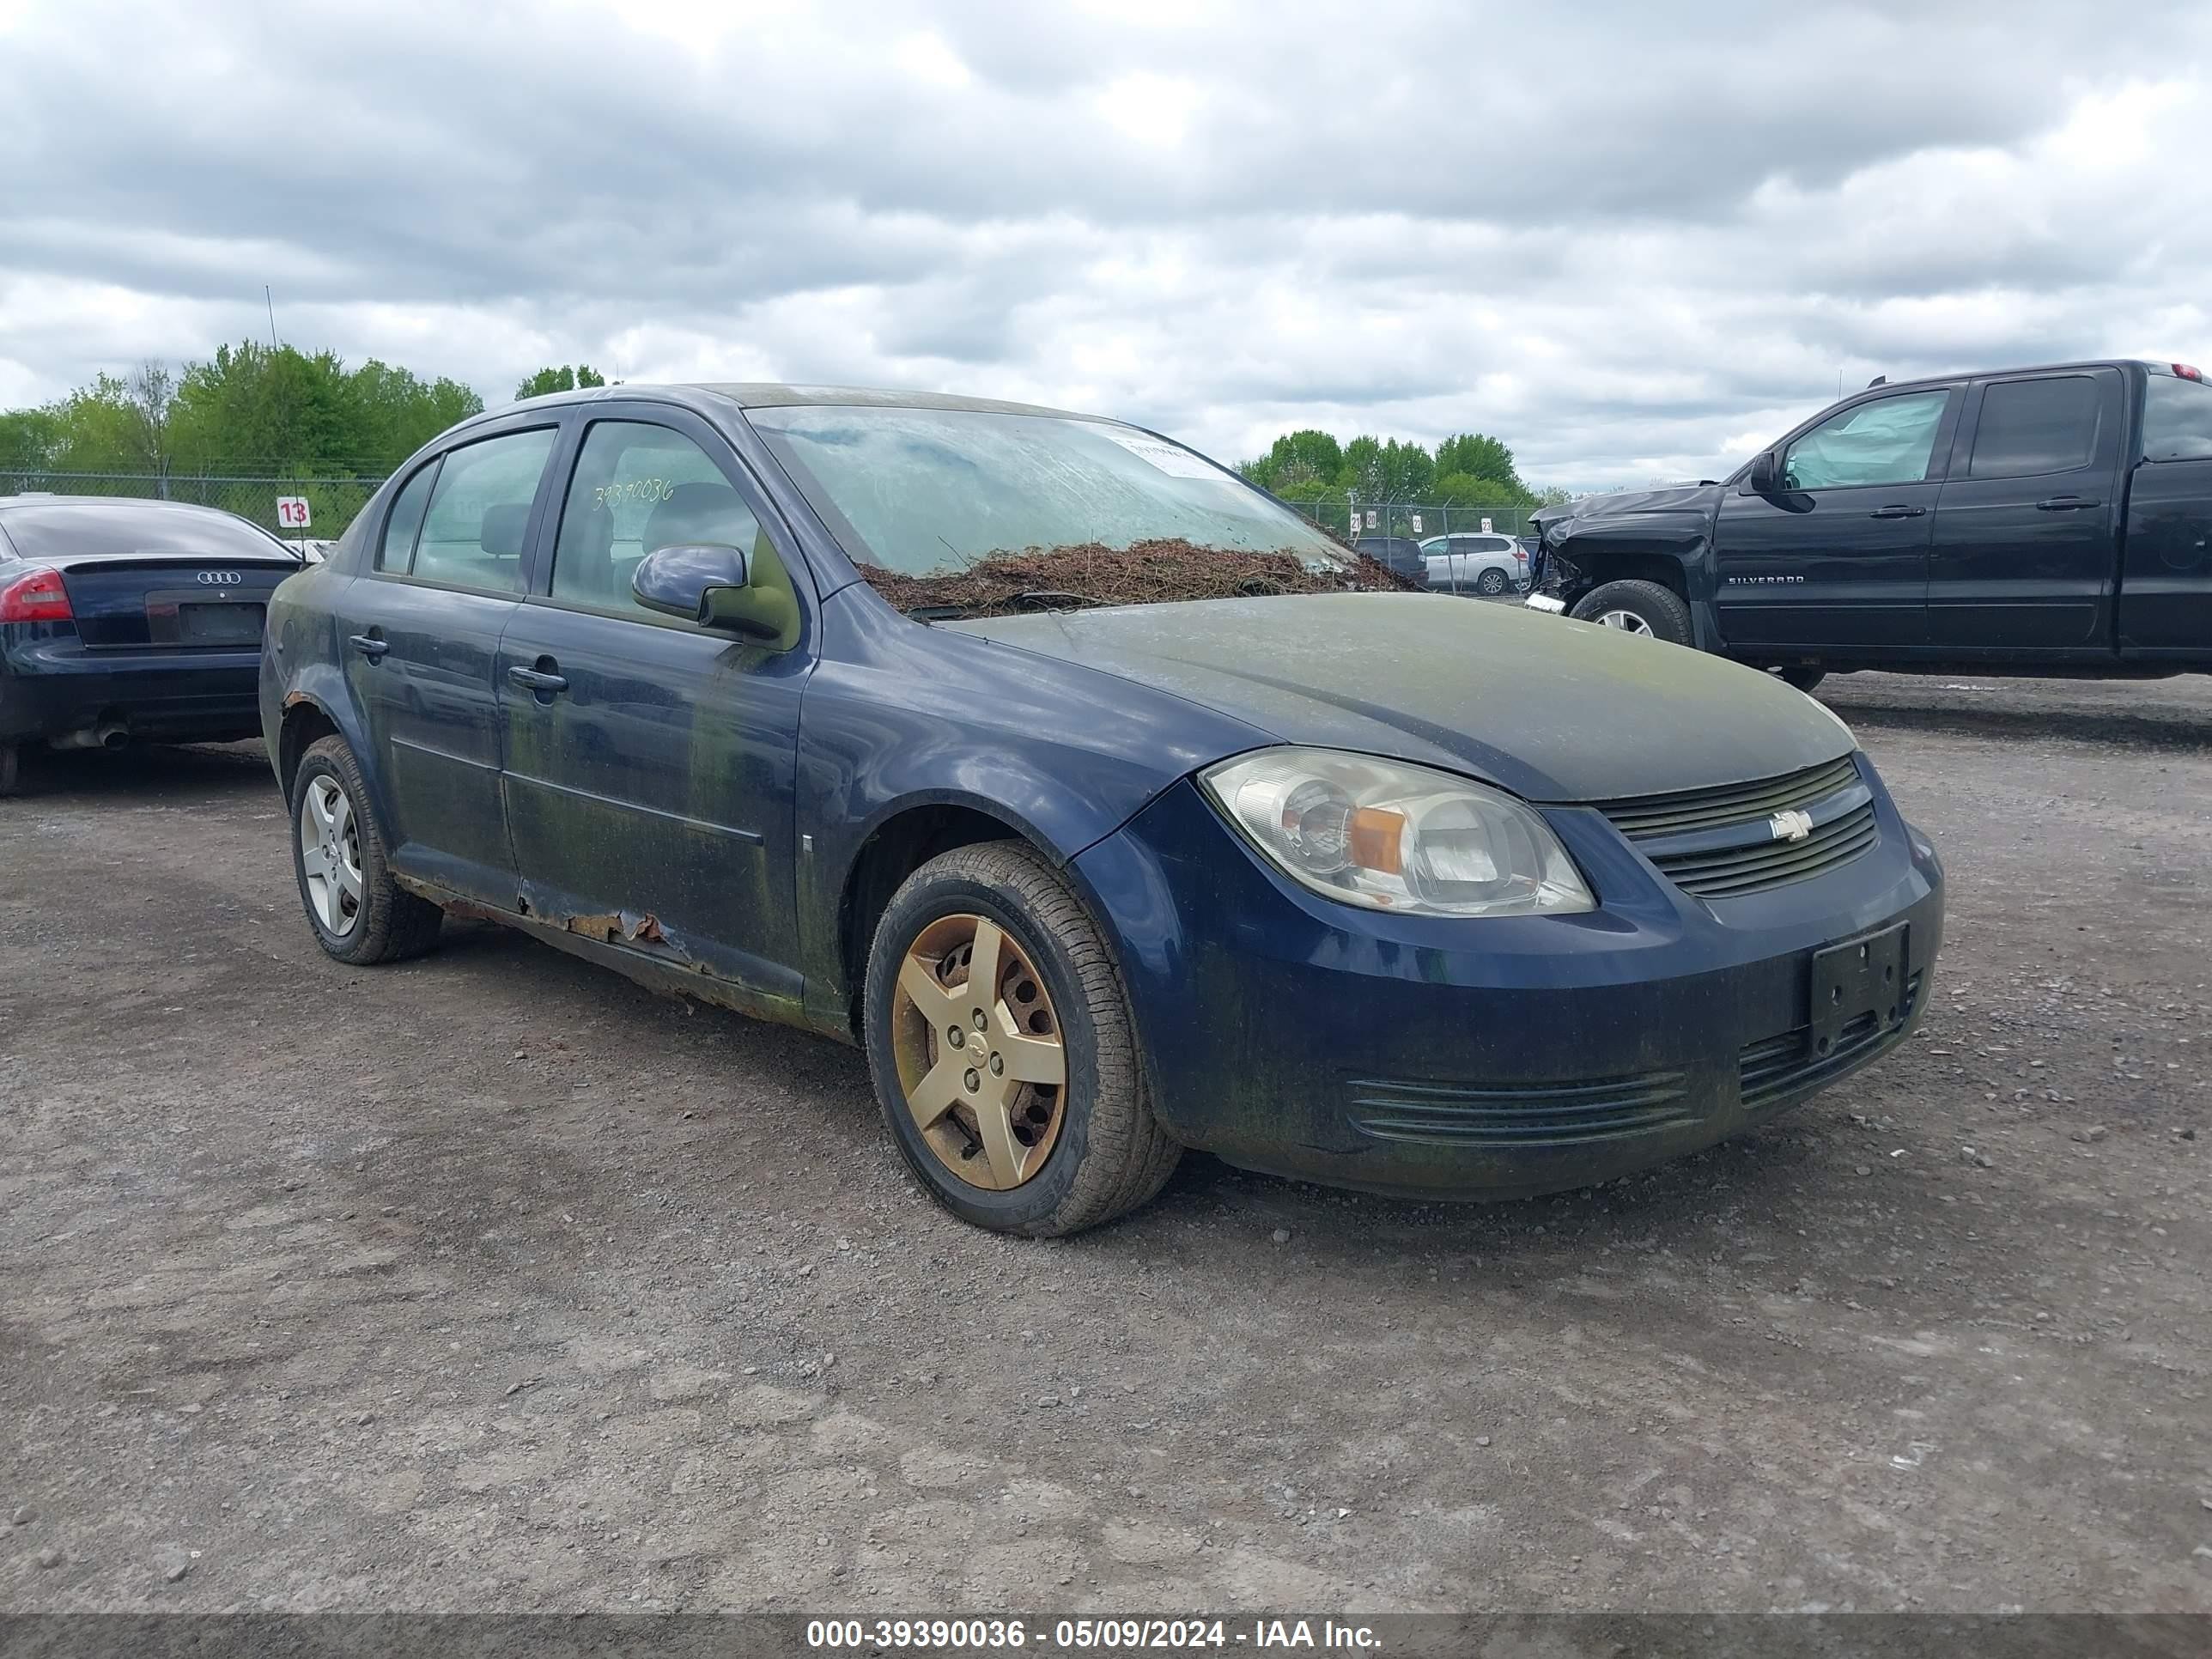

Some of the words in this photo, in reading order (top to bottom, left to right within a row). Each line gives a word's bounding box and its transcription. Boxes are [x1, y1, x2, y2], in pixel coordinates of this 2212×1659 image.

[592, 478, 674, 512] 39390036
[281, 502, 307, 522] 13
[1351, 517, 1360, 529] 21
[1367, 515, 1376, 526] 20
[1413, 519, 1421, 529] 22
[1482, 521, 1491, 532] 23
[1729, 576, 1804, 585] SILVERADO
